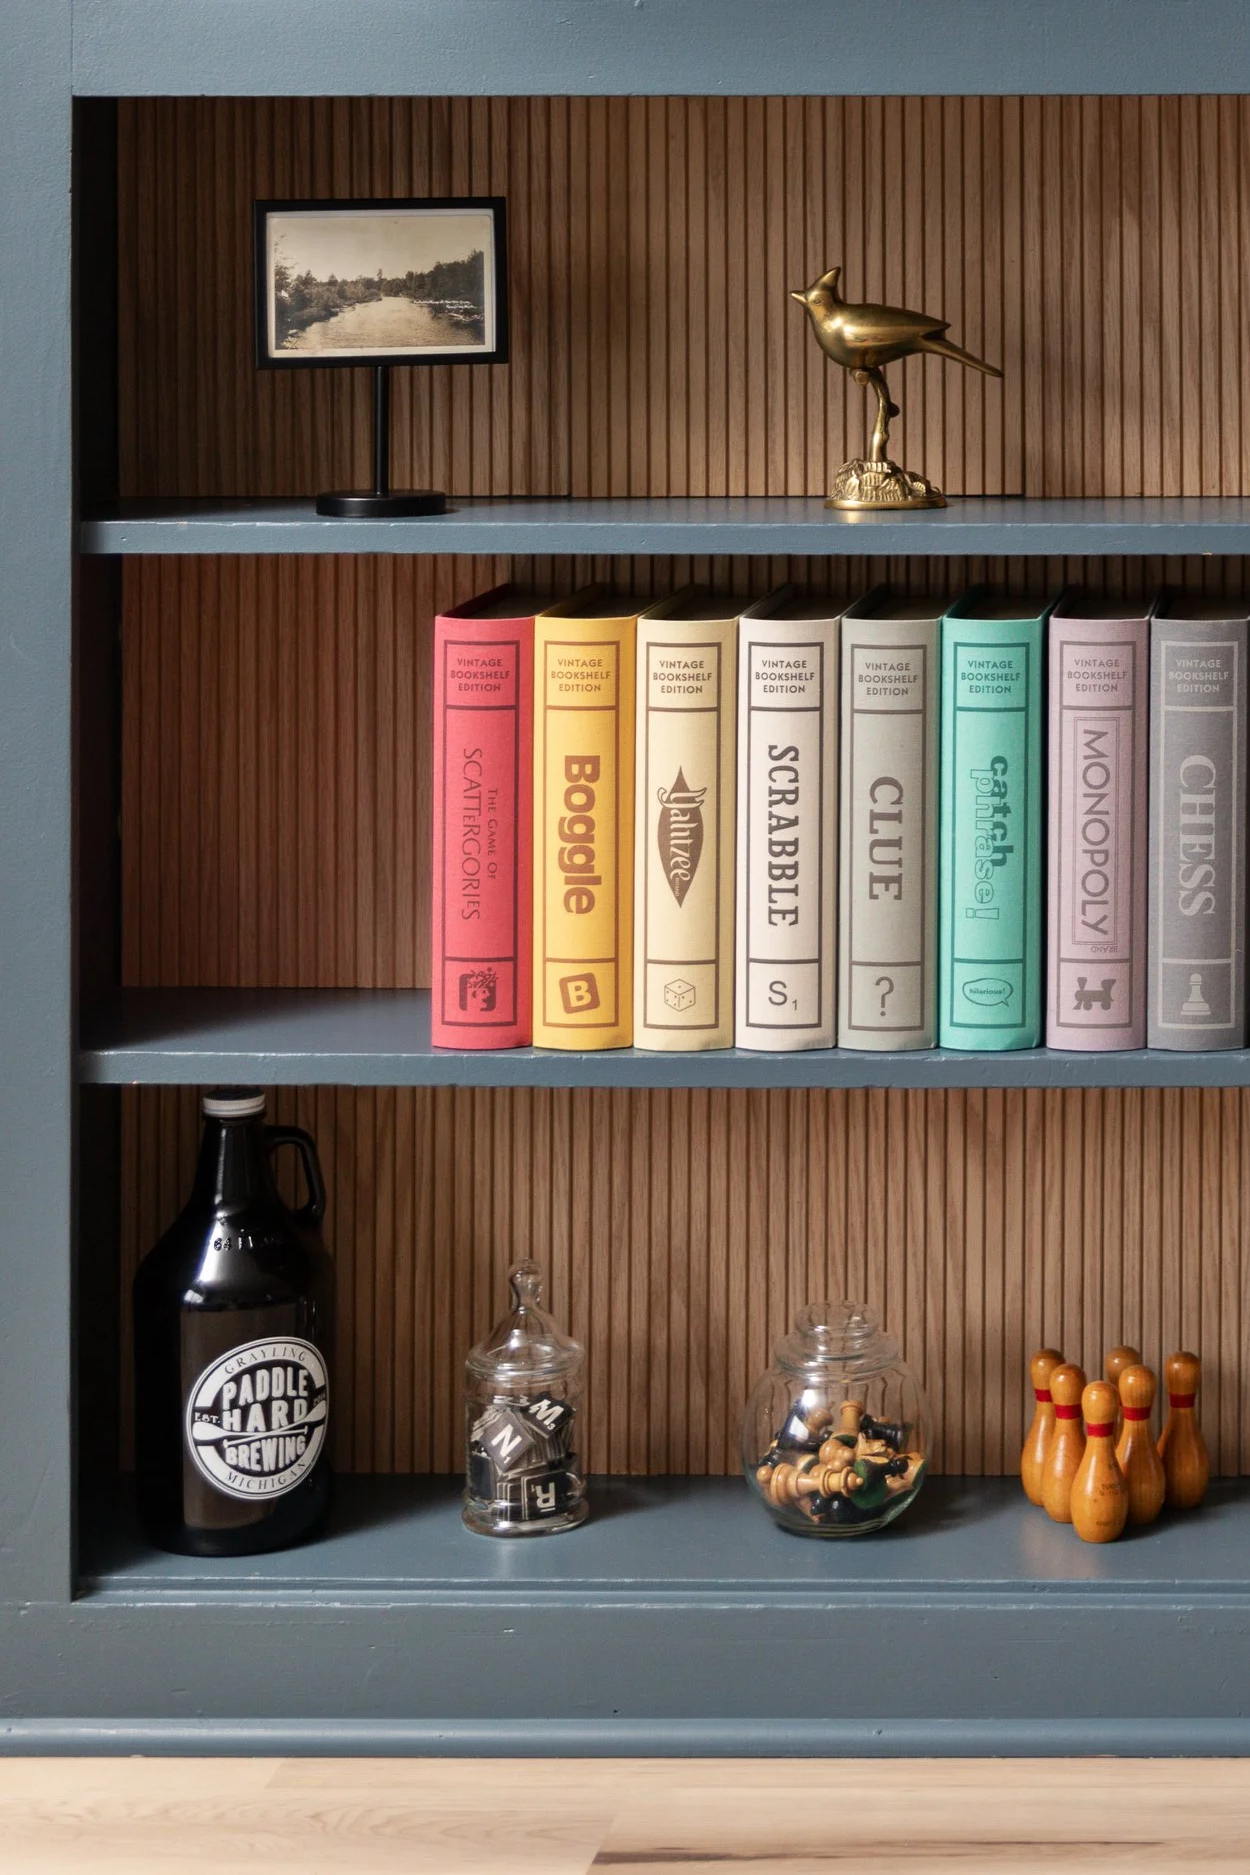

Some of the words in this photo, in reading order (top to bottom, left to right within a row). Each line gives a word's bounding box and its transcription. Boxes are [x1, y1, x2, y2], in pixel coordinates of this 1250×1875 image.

[456, 657, 503, 668] VINTAGE
[557, 658, 603, 668] VINTAGE
[659, 659, 705, 670] VINTAGE
[761, 659, 808, 670] VINTAGE
[865, 662, 911, 672] VINTAGE
[967, 659, 1014, 670] VINTAGE
[1074, 658, 1121, 668] VINTAGE
[1175, 658, 1222, 669] VINTAGE
[449, 669, 510, 680] BOOKSHELF
[550, 670, 611, 680] BOOKSHELF
[652, 671, 713, 682] BOOKSHELF
[754, 671, 815, 682] BOOKSHELF
[858, 674, 919, 684] BOOKSHELF
[960, 671, 1021, 682] BOOKSHELF
[1067, 670, 1128, 681] BOOKSHELF
[1168, 670, 1230, 681] BOOKSHELF
[457, 683, 501, 693] EDITION
[558, 683, 601, 693] EDITION
[660, 685, 703, 695] EDITION
[762, 685, 806, 695] EDITION
[866, 687, 909, 697] EDITION
[968, 685, 1012, 695] EDITION
[1075, 683, 1119, 693] EDITION
[1176, 683, 1221, 693] EDITION
[487, 788, 498, 812] THE
[990, 755, 1014, 867] catch
[461, 748, 483, 920] SCATTERGORIES
[487, 819, 498, 855] GAME
[557, 755, 602, 915] Boggle
[657, 787, 707, 881] Yahtzee
[767, 744, 800, 927] SCRABBLE
[1081, 729, 1110, 935] MONOPOLY
[1178, 754, 1217, 916] CHESS
[868, 776, 905, 901] CLUE
[965, 768, 1001, 920] phrase!
[487, 862, 498, 880] OF
[1090, 945, 1118, 954] BRAND
[569, 983, 591, 1008] B
[768, 980, 788, 1007] S
[224, 1346, 307, 1375] GRAYLING
[222, 1366, 309, 1410] PADDLE
[194, 1411, 221, 1424] EST.
[222, 1398, 309, 1433] HARD
[491, 1424, 523, 1462] N
[225, 1435, 307, 1473] BREWING
[225, 1462, 308, 1491] MICHIGAN
[535, 1482, 556, 1508] R
